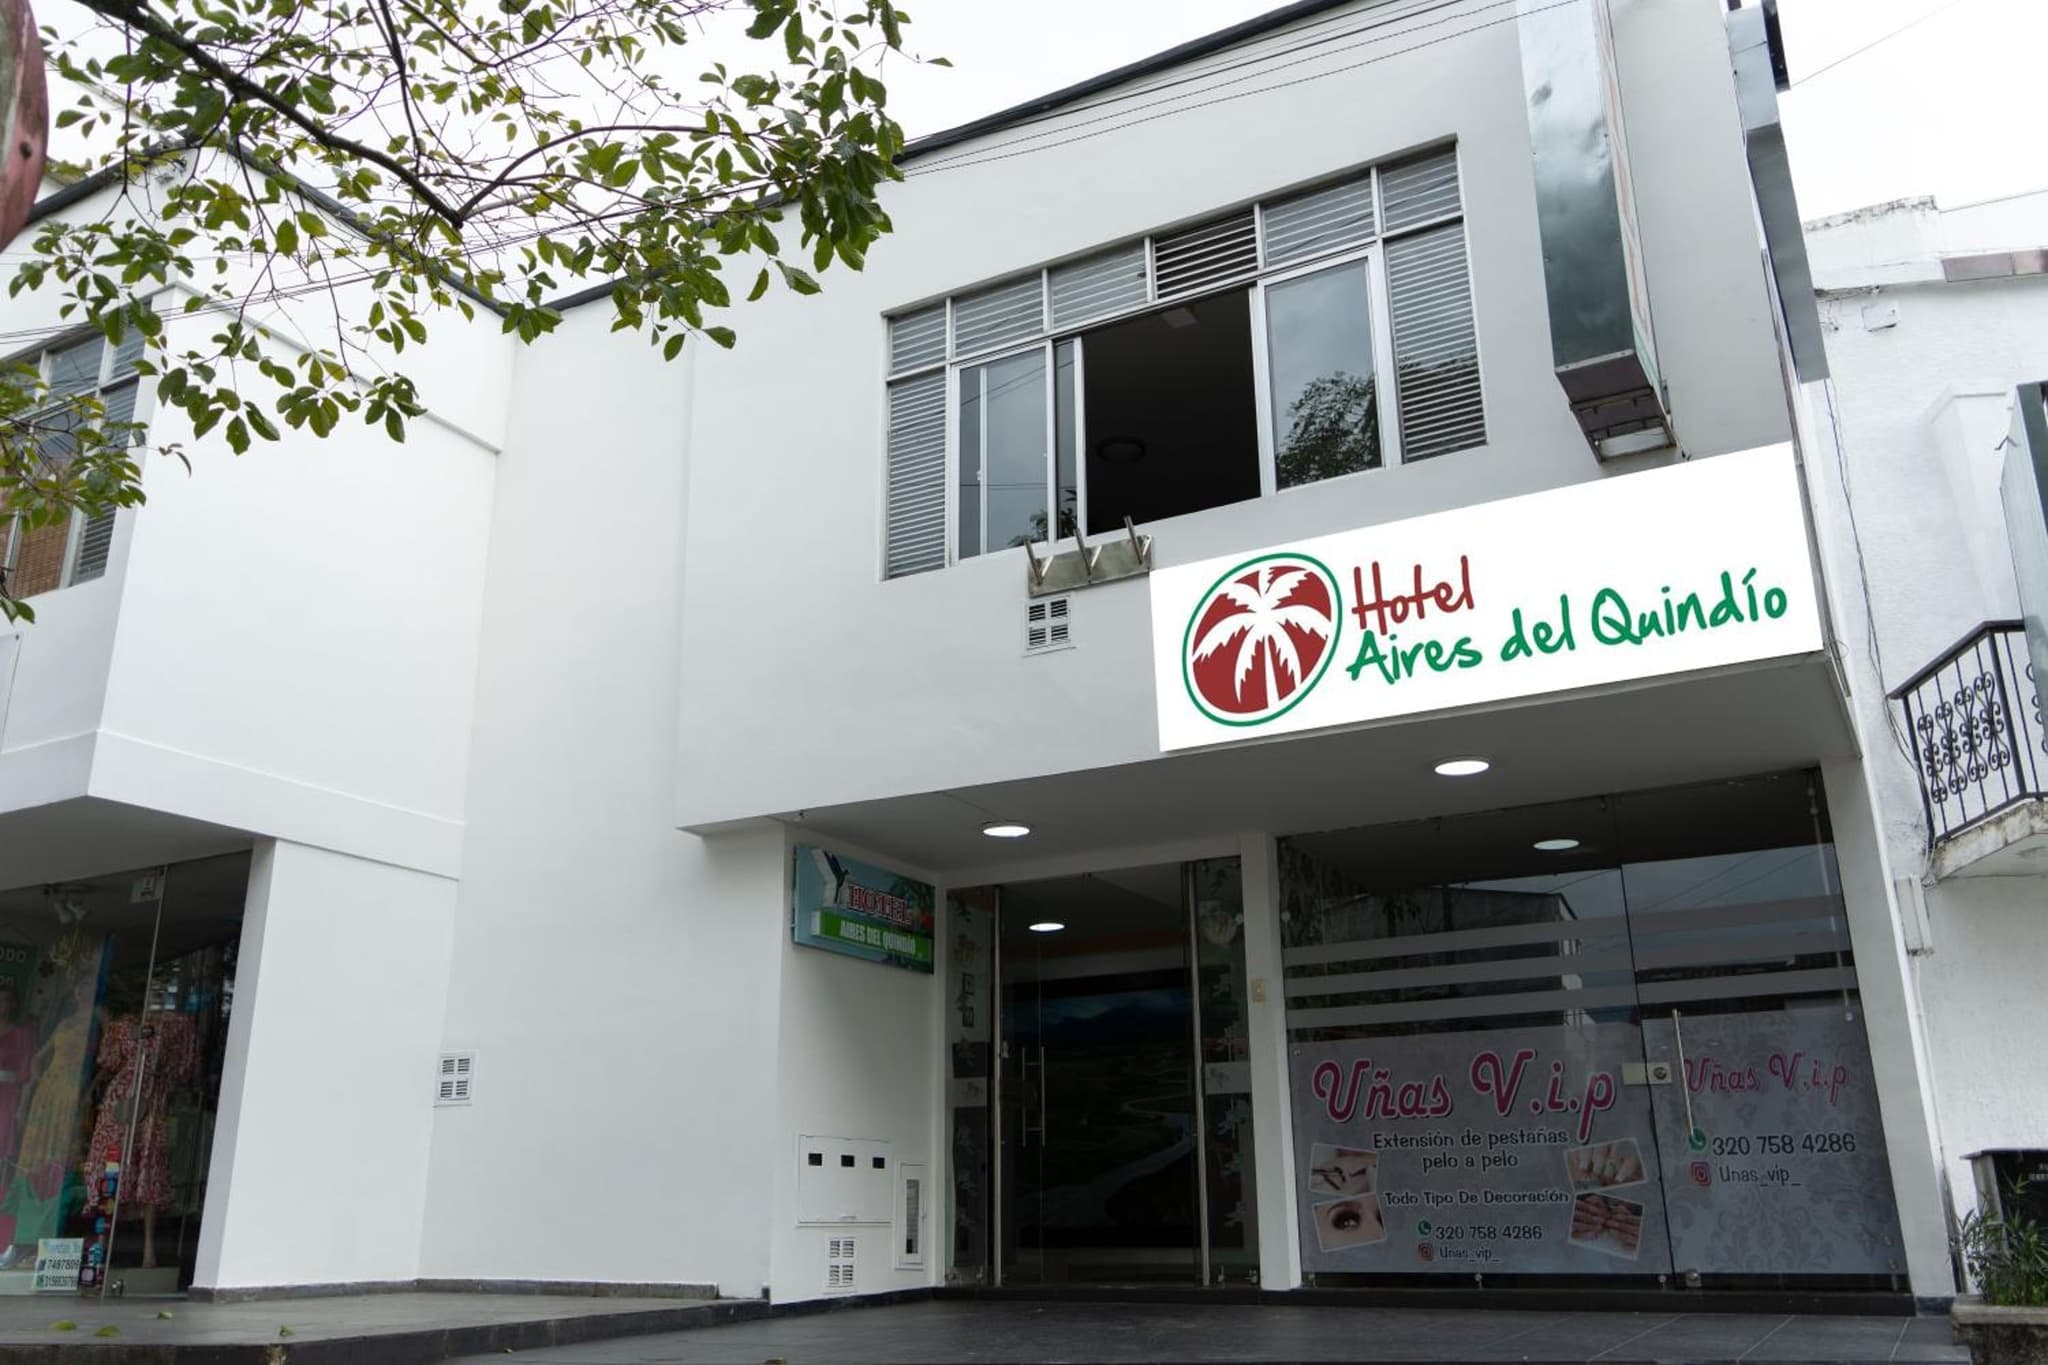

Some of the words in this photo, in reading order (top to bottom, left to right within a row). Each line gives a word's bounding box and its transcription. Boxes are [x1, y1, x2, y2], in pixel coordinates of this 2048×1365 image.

[1352, 556, 1474, 634] Hotel
[1347, 628, 1484, 685] Aires
[1499, 593, 1577, 662] del
[1590, 568, 1788, 647] Quindío
[848, 884, 912, 925] HOTEL
[840, 919, 865, 942] AIRES
[867, 926, 881, 946] DEL
[1769, 1051, 1848, 1106] V.i.p
[1312, 1058, 1453, 1122] Uñas
[1470, 1049, 1616, 1143] V.i.p
[1373, 1131, 1454, 1149] Extensión
[1461, 1129, 1482, 1146] de
[1488, 1128, 1568, 1150] pestañas
[1711, 1136, 1750, 1156] 320
[1755, 1134, 1795, 1154] 758
[1802, 1132, 1856, 1153] 4286
[1423, 1151, 1458, 1172] pelo
[1465, 1157, 1475, 1167] a
[1482, 1150, 1519, 1171] pelo
[1385, 1191, 1418, 1205] Todo
[1424, 1191, 1454, 1207] Tipo
[1459, 1191, 1478, 1204] De
[1484, 1189, 1568, 1204] Decoración
[1435, 1225, 1465, 1240] 320
[1470, 1226, 1497, 1240] 758
[1502, 1225, 1543, 1240] 4286
